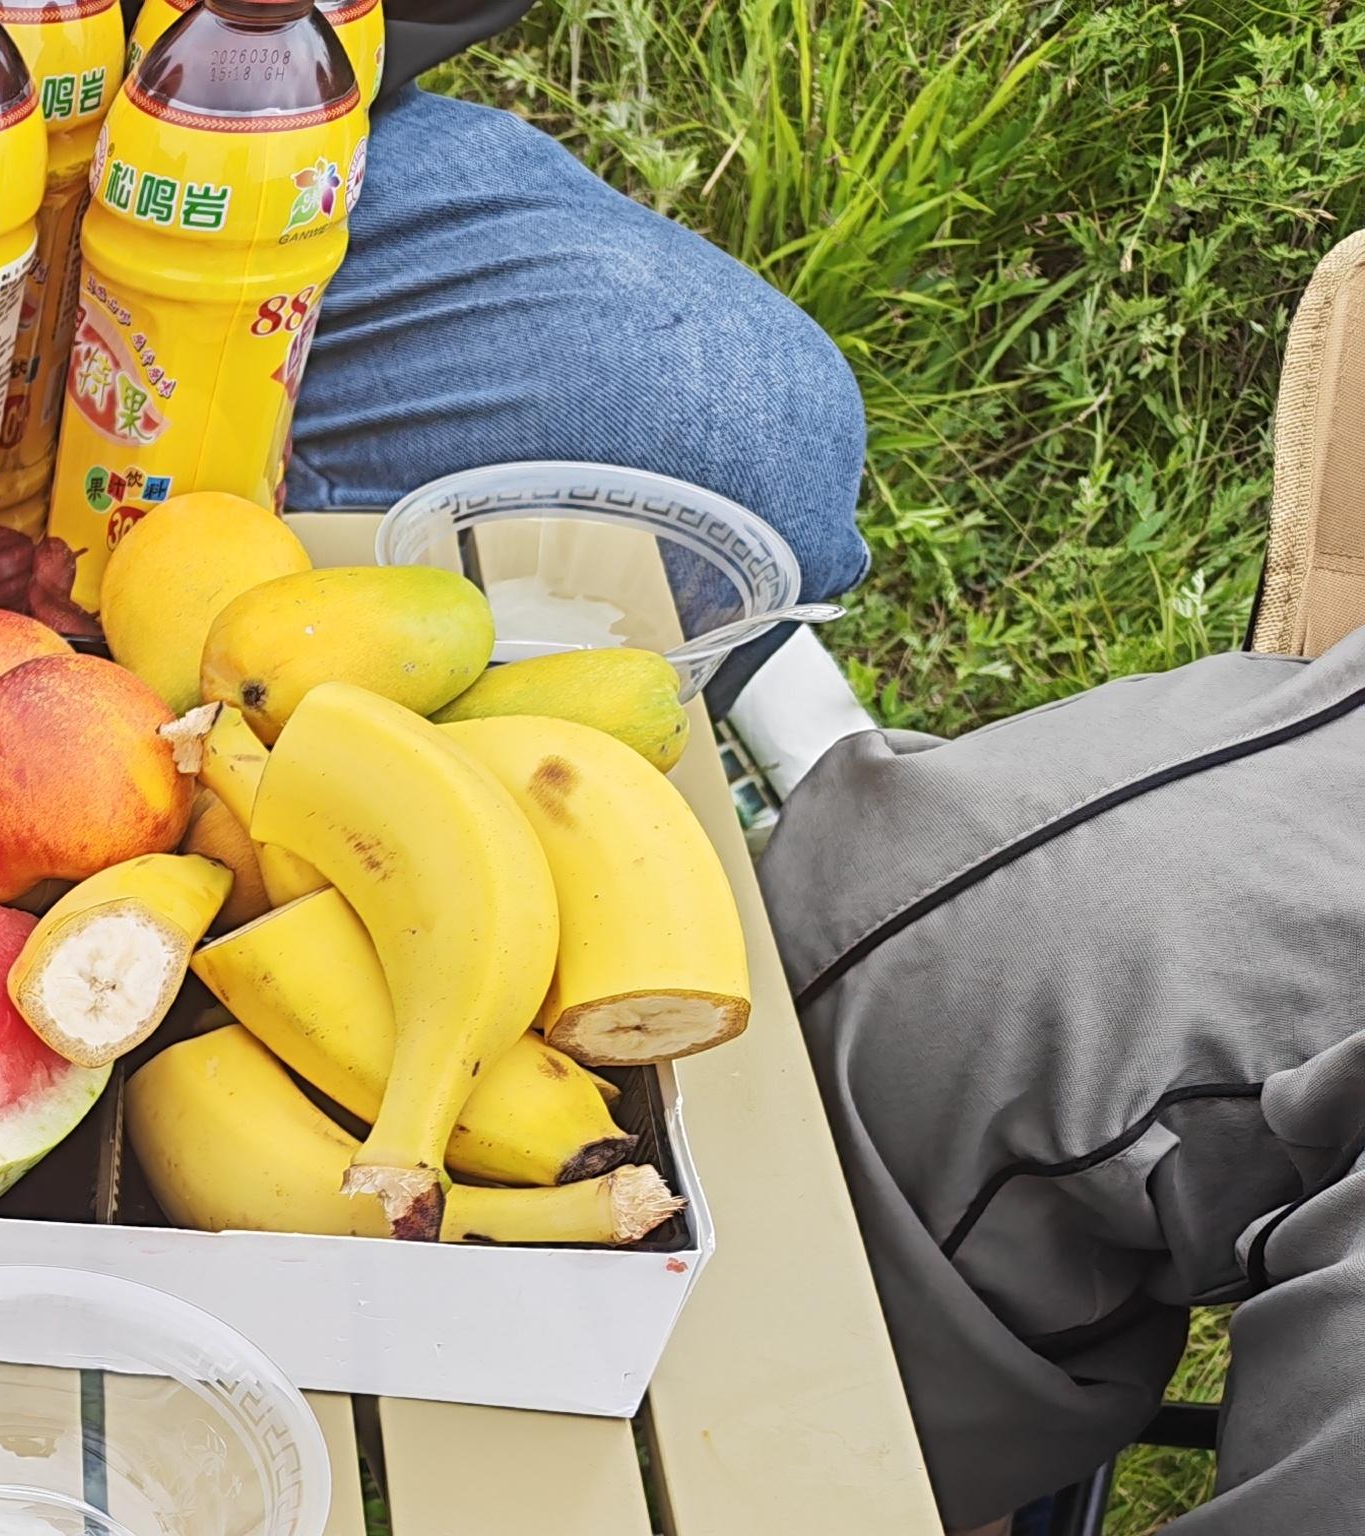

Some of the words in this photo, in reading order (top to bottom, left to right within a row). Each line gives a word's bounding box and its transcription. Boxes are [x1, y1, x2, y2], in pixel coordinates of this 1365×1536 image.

[211, 49, 291, 65] 20260308
[264, 67, 285, 80] GH
[42, 68, 105, 119] 鸣岩
[107, 162, 229, 229] 松鸣岩
[250, 286, 314, 336] 88
[87, 470, 168, 502] 果汁饮料
